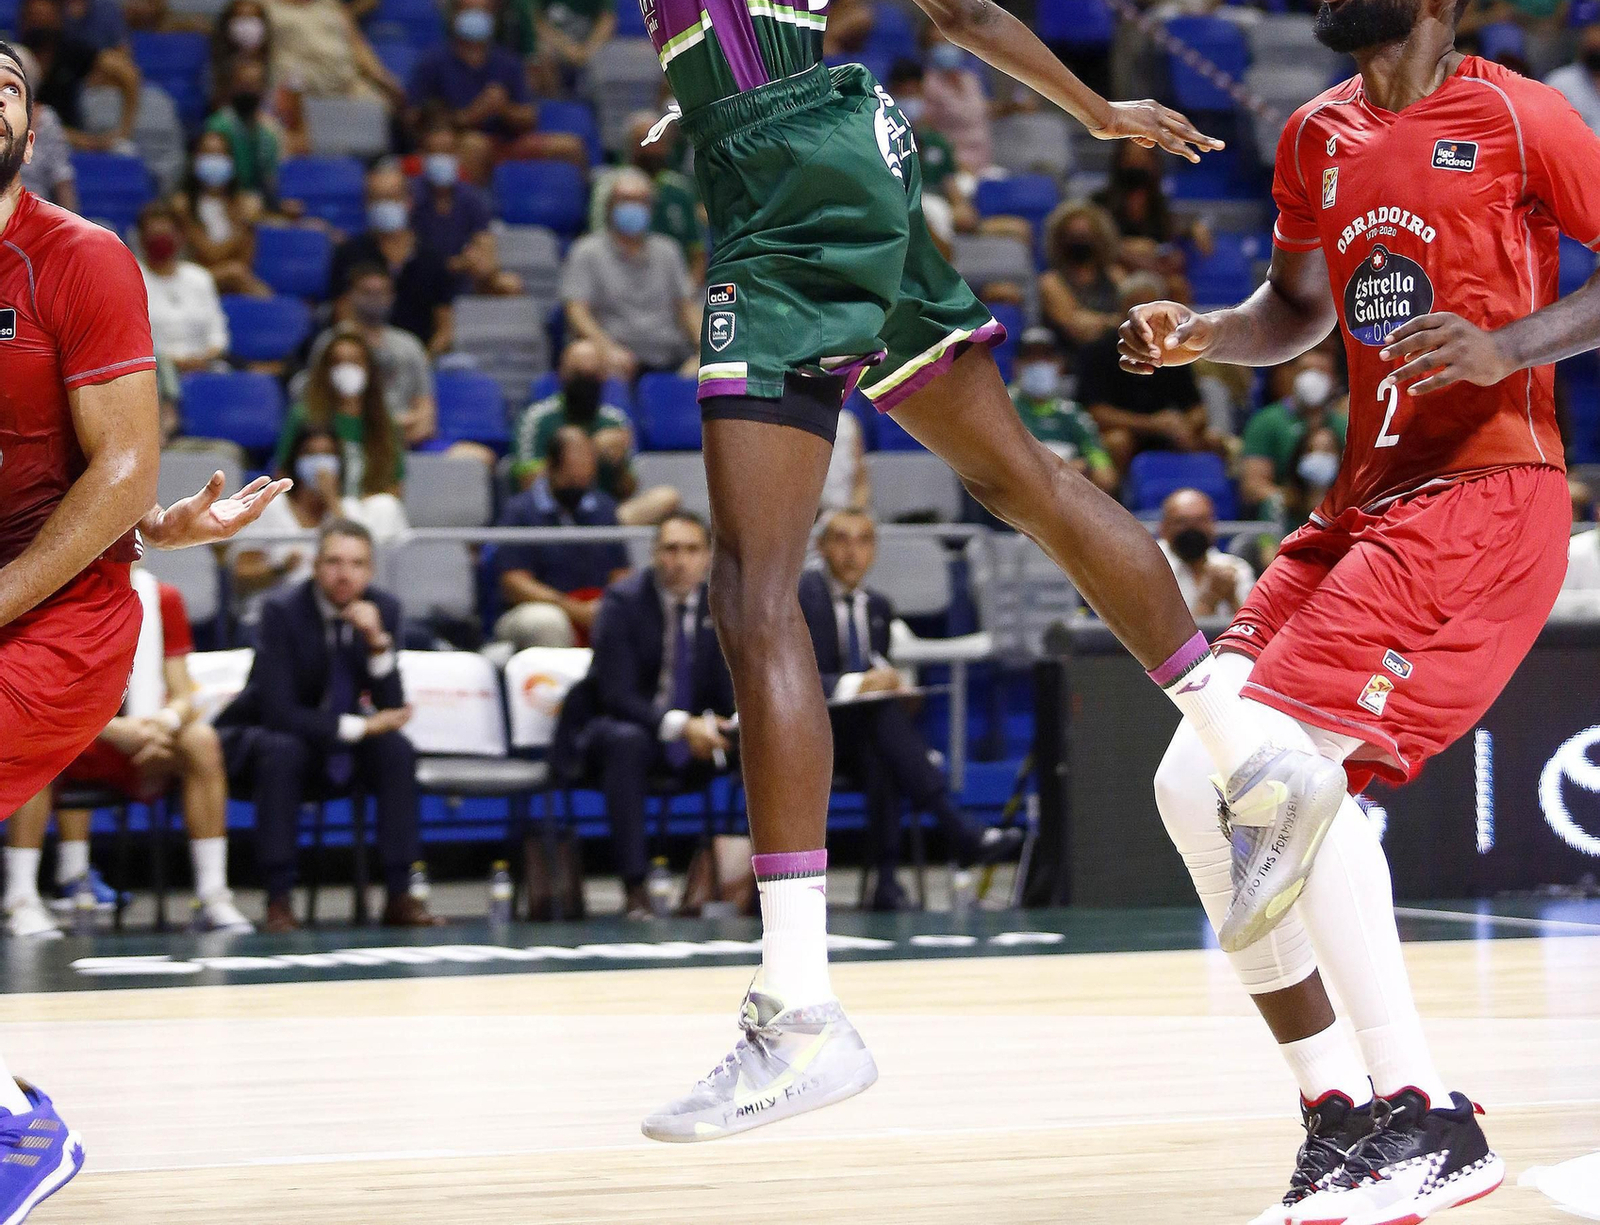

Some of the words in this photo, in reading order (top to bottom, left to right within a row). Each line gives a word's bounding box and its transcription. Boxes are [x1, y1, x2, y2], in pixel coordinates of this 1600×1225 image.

[1436, 157, 1472, 167] endesa
[1437, 148, 1455, 158] liga
[1337, 206, 1437, 255] OBRADOIRO
[710, 292, 729, 303] acb
[1355, 271, 1415, 300] Estrella
[1354, 294, 1411, 323] Galicia
[1374, 376, 1400, 448] 2
[1385, 657, 1404, 674] acb
[1247, 878, 1261, 897] DO
[1259, 857, 1276, 877] THIS
[722, 1096, 776, 1124] FAMILY
[784, 1076, 820, 1100] FIRS
